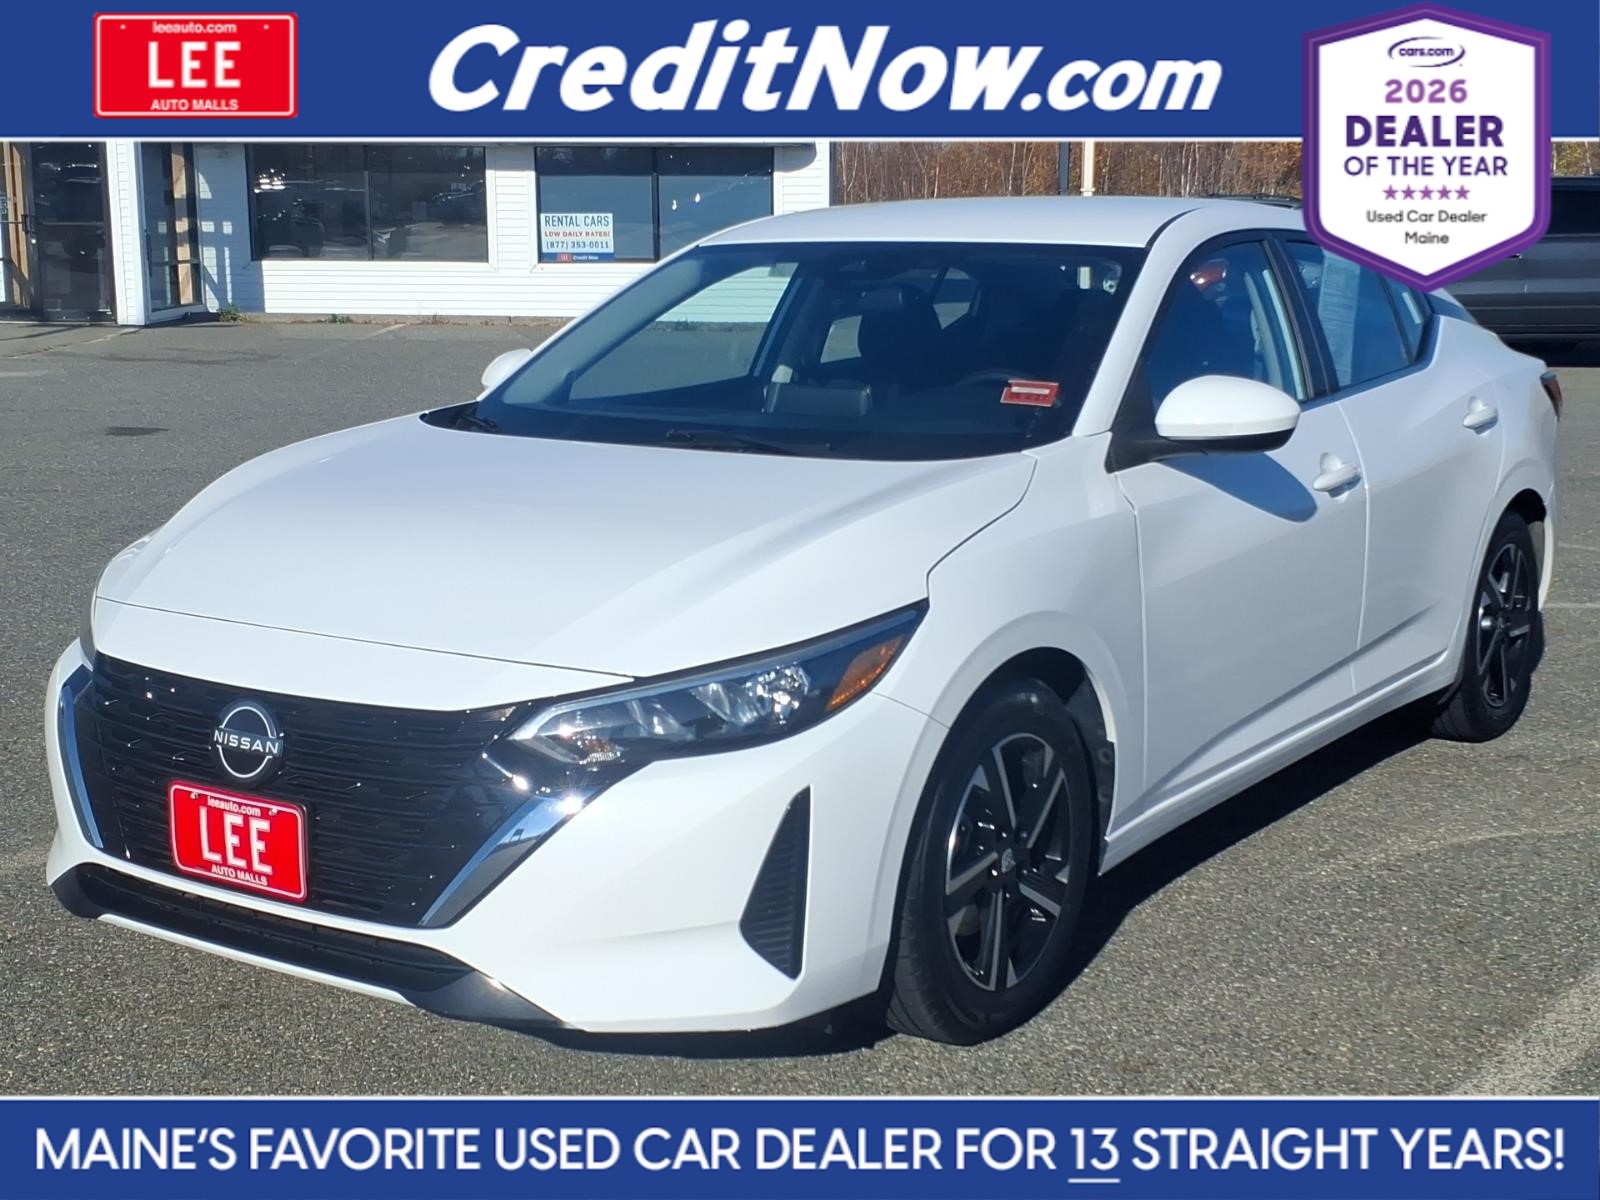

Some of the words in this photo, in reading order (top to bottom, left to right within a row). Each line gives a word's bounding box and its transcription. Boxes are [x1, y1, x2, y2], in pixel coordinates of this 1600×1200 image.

[544, 215, 581, 227] RENTAL
[583, 215, 610, 227] CARS
[546, 241, 569, 249] (877)
[571, 241, 609, 249] 353-0011
[214, 730, 278, 754] NISSAN
[207, 795, 261, 817] leeauto.com
[199, 806, 273, 876] LEE
[211, 864, 236, 878] AUTO
[236, 870, 268, 887] MALLS
